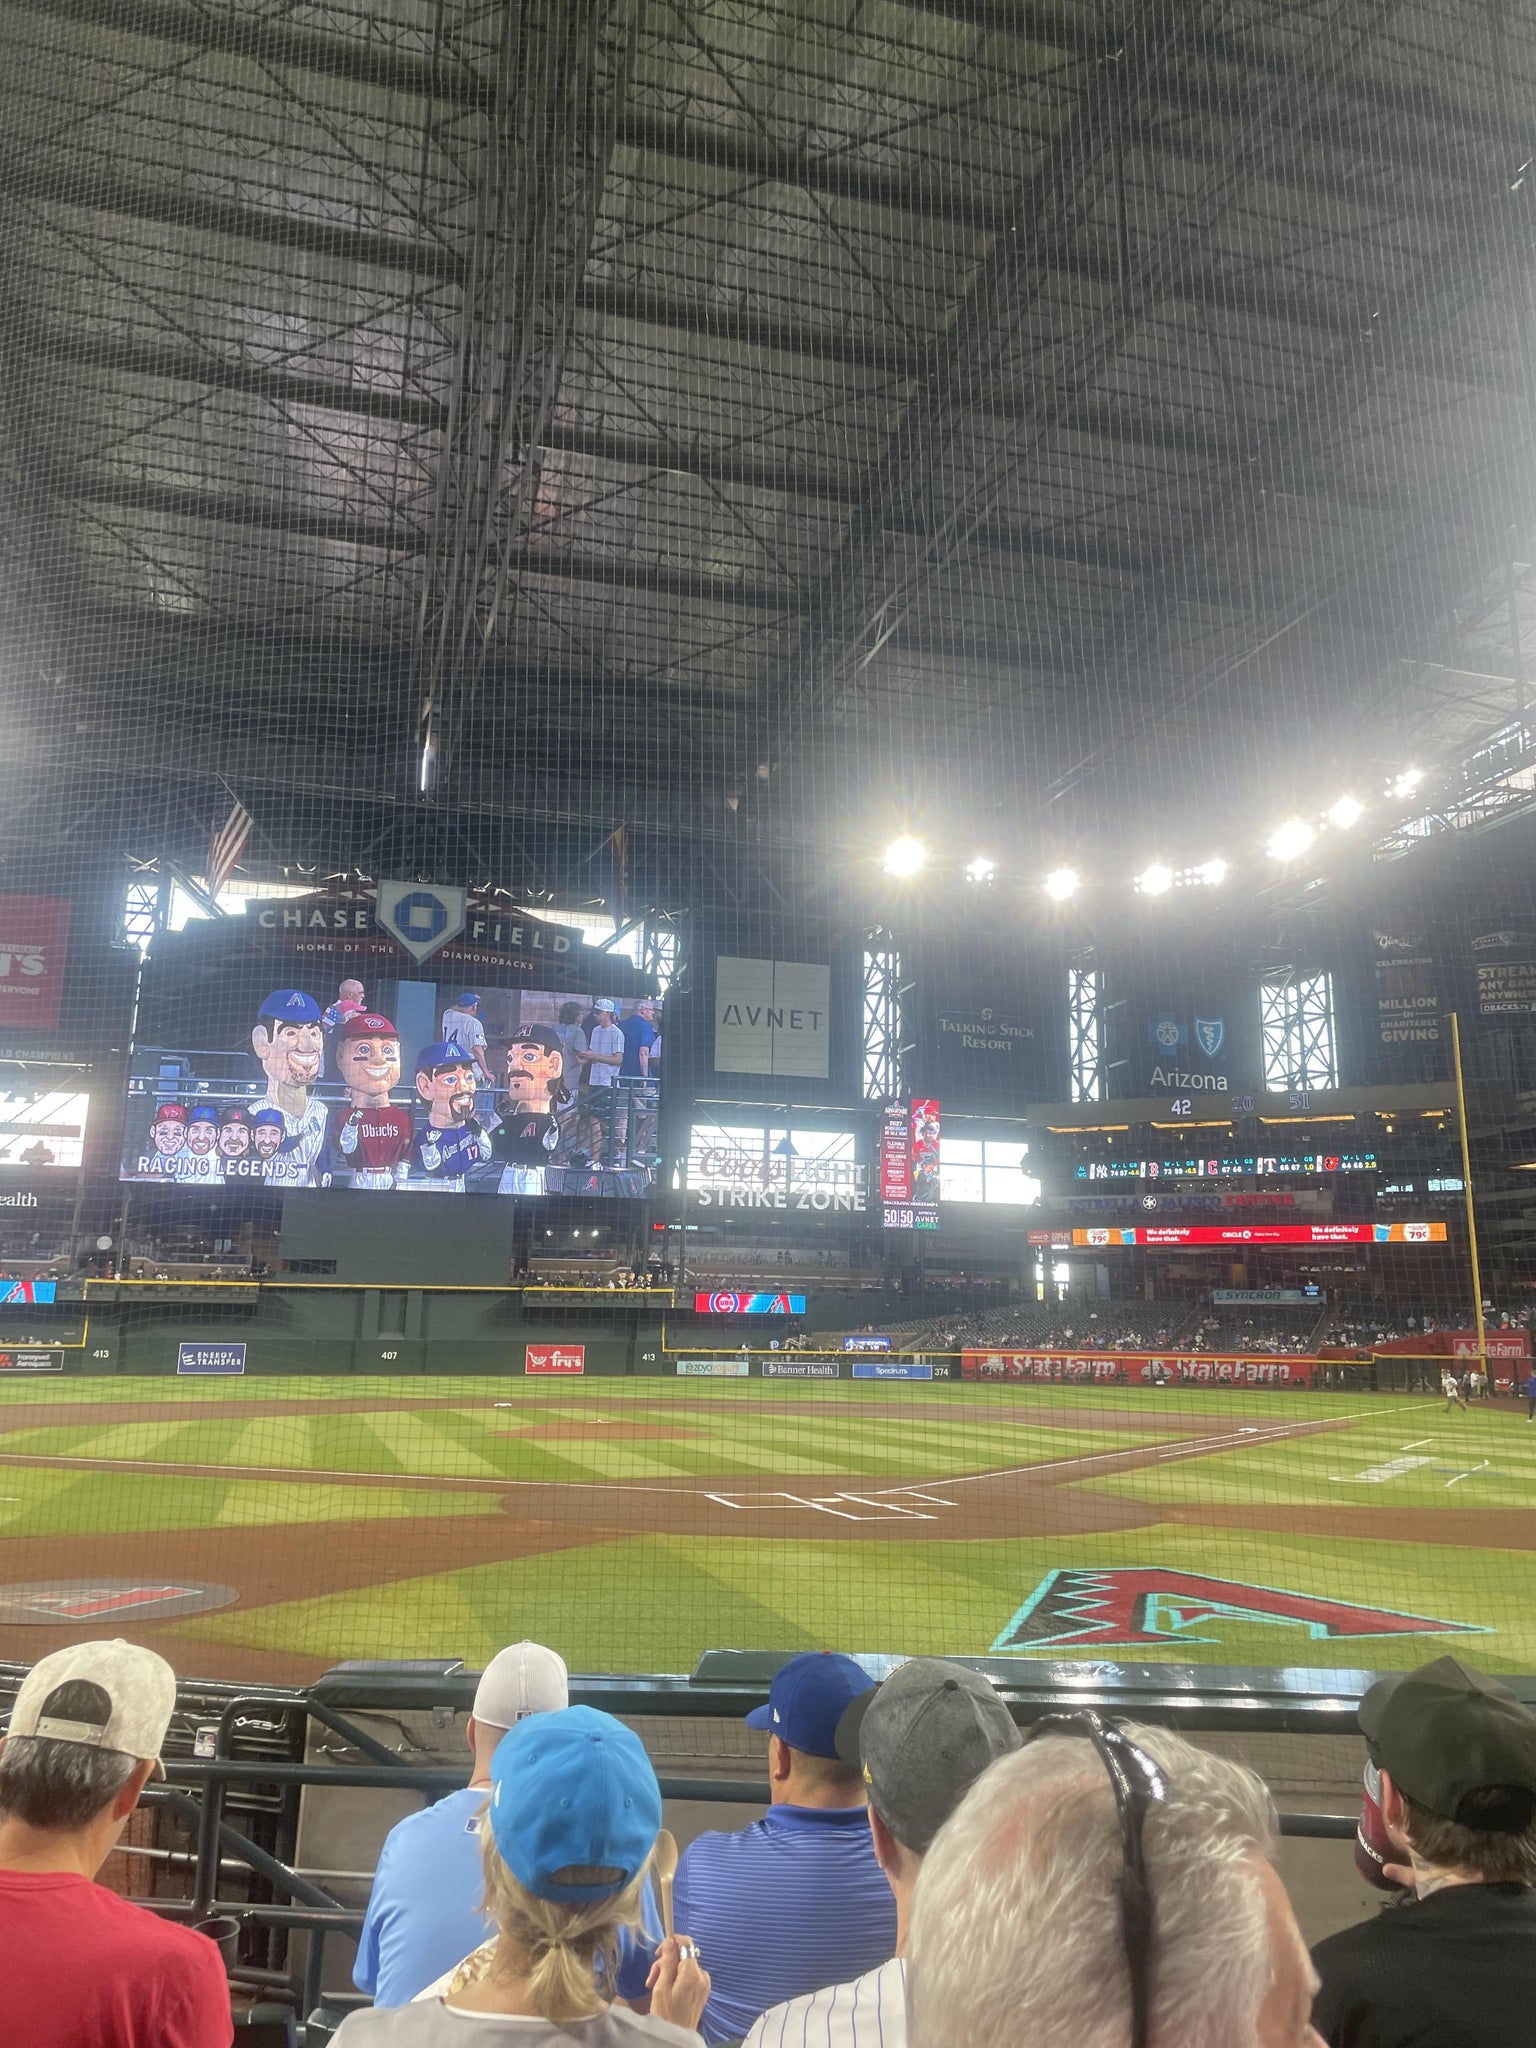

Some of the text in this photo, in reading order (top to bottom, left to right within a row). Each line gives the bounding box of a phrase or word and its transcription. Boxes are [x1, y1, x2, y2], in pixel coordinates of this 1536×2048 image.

[258, 909, 571, 953] CHASE FIELD
[296, 943, 534, 970] HOME OF THE DIAMONDBACKS
[1376, 957, 1433, 967] CELEBRATING
[1479, 981, 1503, 991] ANY
[1379, 997, 1438, 1010] MILLION
[722, 1004, 823, 1031] AVNET
[1403, 1011, 1415, 1019] IN
[1380, 1019, 1438, 1029] CHARITABLE
[1381, 1028, 1440, 1043] GIVING
[15, 1049, 75, 1061] CHAMPIONS
[1150, 1066, 1228, 1091] Arizona
[1170, 1099, 1192, 1115] 42
[1231, 1096, 1256, 1112] 20
[1289, 1092, 1311, 1110] 51
[466, 1144, 478, 1161] 17
[138, 1156, 299, 1178] RACING LEGENDS
[700, 1146, 866, 1185] Coors LIGHT
[1341, 1161, 1352, 1169] 64
[698, 1184, 868, 1213] STRIKE ZONE
[1069, 1193, 1295, 1210] ESTRELLA JALISCO CANTINA
[1158, 1228, 1190, 1236] definitely
[1324, 1225, 1360, 1234] definitely
[1226, 1291, 1281, 1300] SYNCRON
[92, 1350, 110, 1359] 413
[196, 1351, 234, 1359] ENERGY
[381, 1351, 398, 1360] 407
[549, 1350, 582, 1368] fry's
[642, 1353, 656, 1361] 413
[196, 1358, 242, 1366] TRANSFER
[777, 1364, 834, 1375] Banner Health
[934, 1368, 949, 1377] 374
